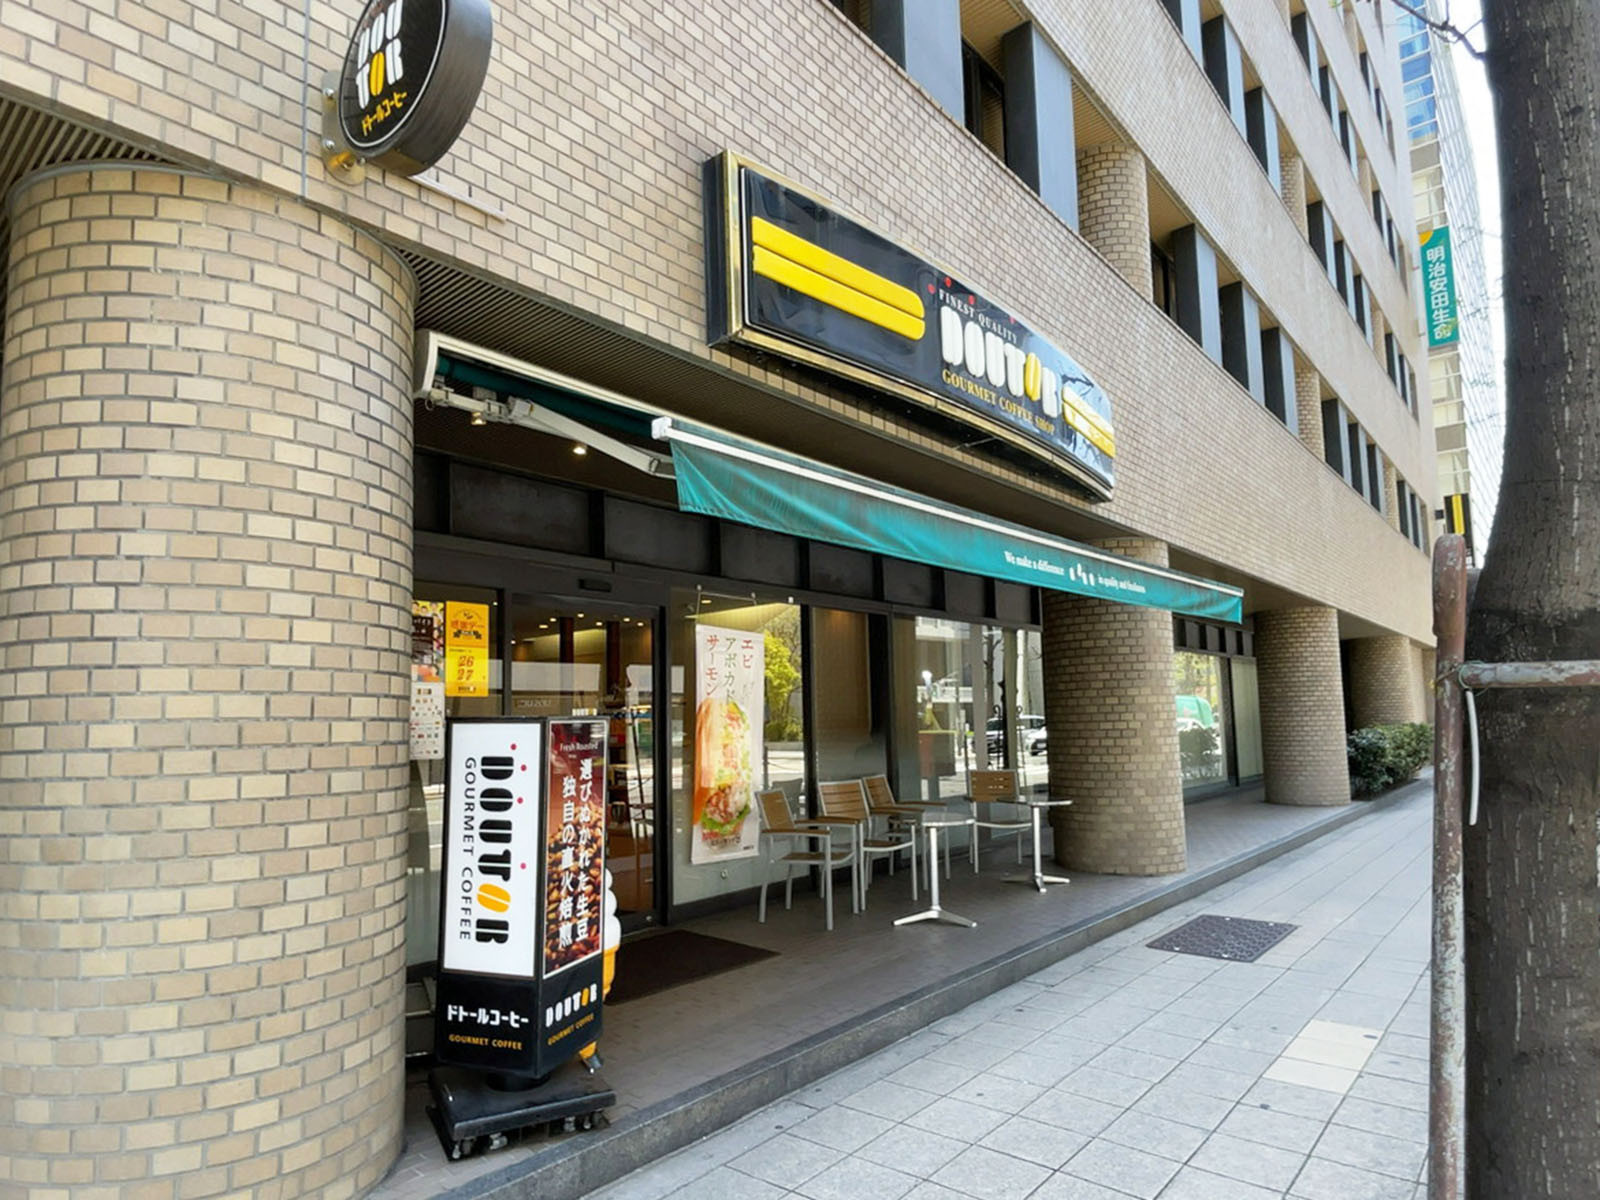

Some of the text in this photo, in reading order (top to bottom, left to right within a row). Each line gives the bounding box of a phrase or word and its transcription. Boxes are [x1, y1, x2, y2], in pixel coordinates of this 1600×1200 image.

[361, 91, 408, 137] ドトールコーヒー
[939, 288, 1018, 344] FINEST QUALITY
[1426, 245, 1452, 340] 明治安田生命
[940, 305, 1060, 419] DOUTOR
[942, 369, 996, 406] GOURMET
[999, 396, 1034, 425] COFFEE
[1004, 550, 1015, 565] We
[705, 635, 719, 697] サーモン
[741, 639, 754, 669] エビ
[459, 757, 476, 940] GOURMET COFFEE
[475, 756, 514, 944] DOUTOR
[447, 1004, 529, 1029] ドトールコーヒー
[545, 983, 597, 1028] DOUTOR
[449, 1033, 523, 1051] GOURMET COFFEE
[548, 1024, 575, 1046] GOURMET
